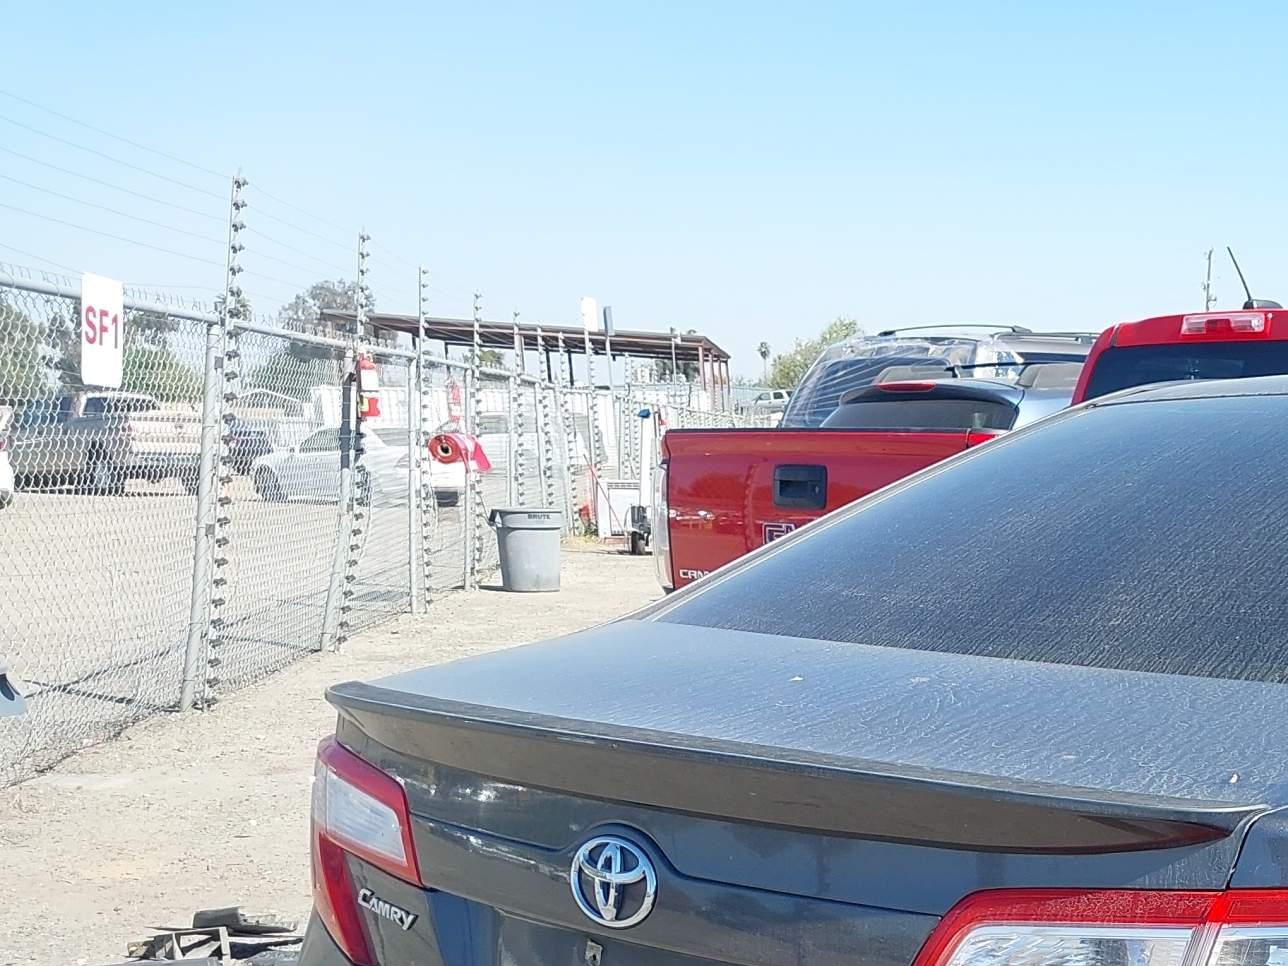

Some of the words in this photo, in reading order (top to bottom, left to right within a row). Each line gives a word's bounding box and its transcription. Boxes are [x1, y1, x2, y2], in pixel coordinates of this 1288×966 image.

[85, 306, 118, 349] SF1
[680, 569, 710, 580] CAN
[358, 888, 416, 930] CAMRY
